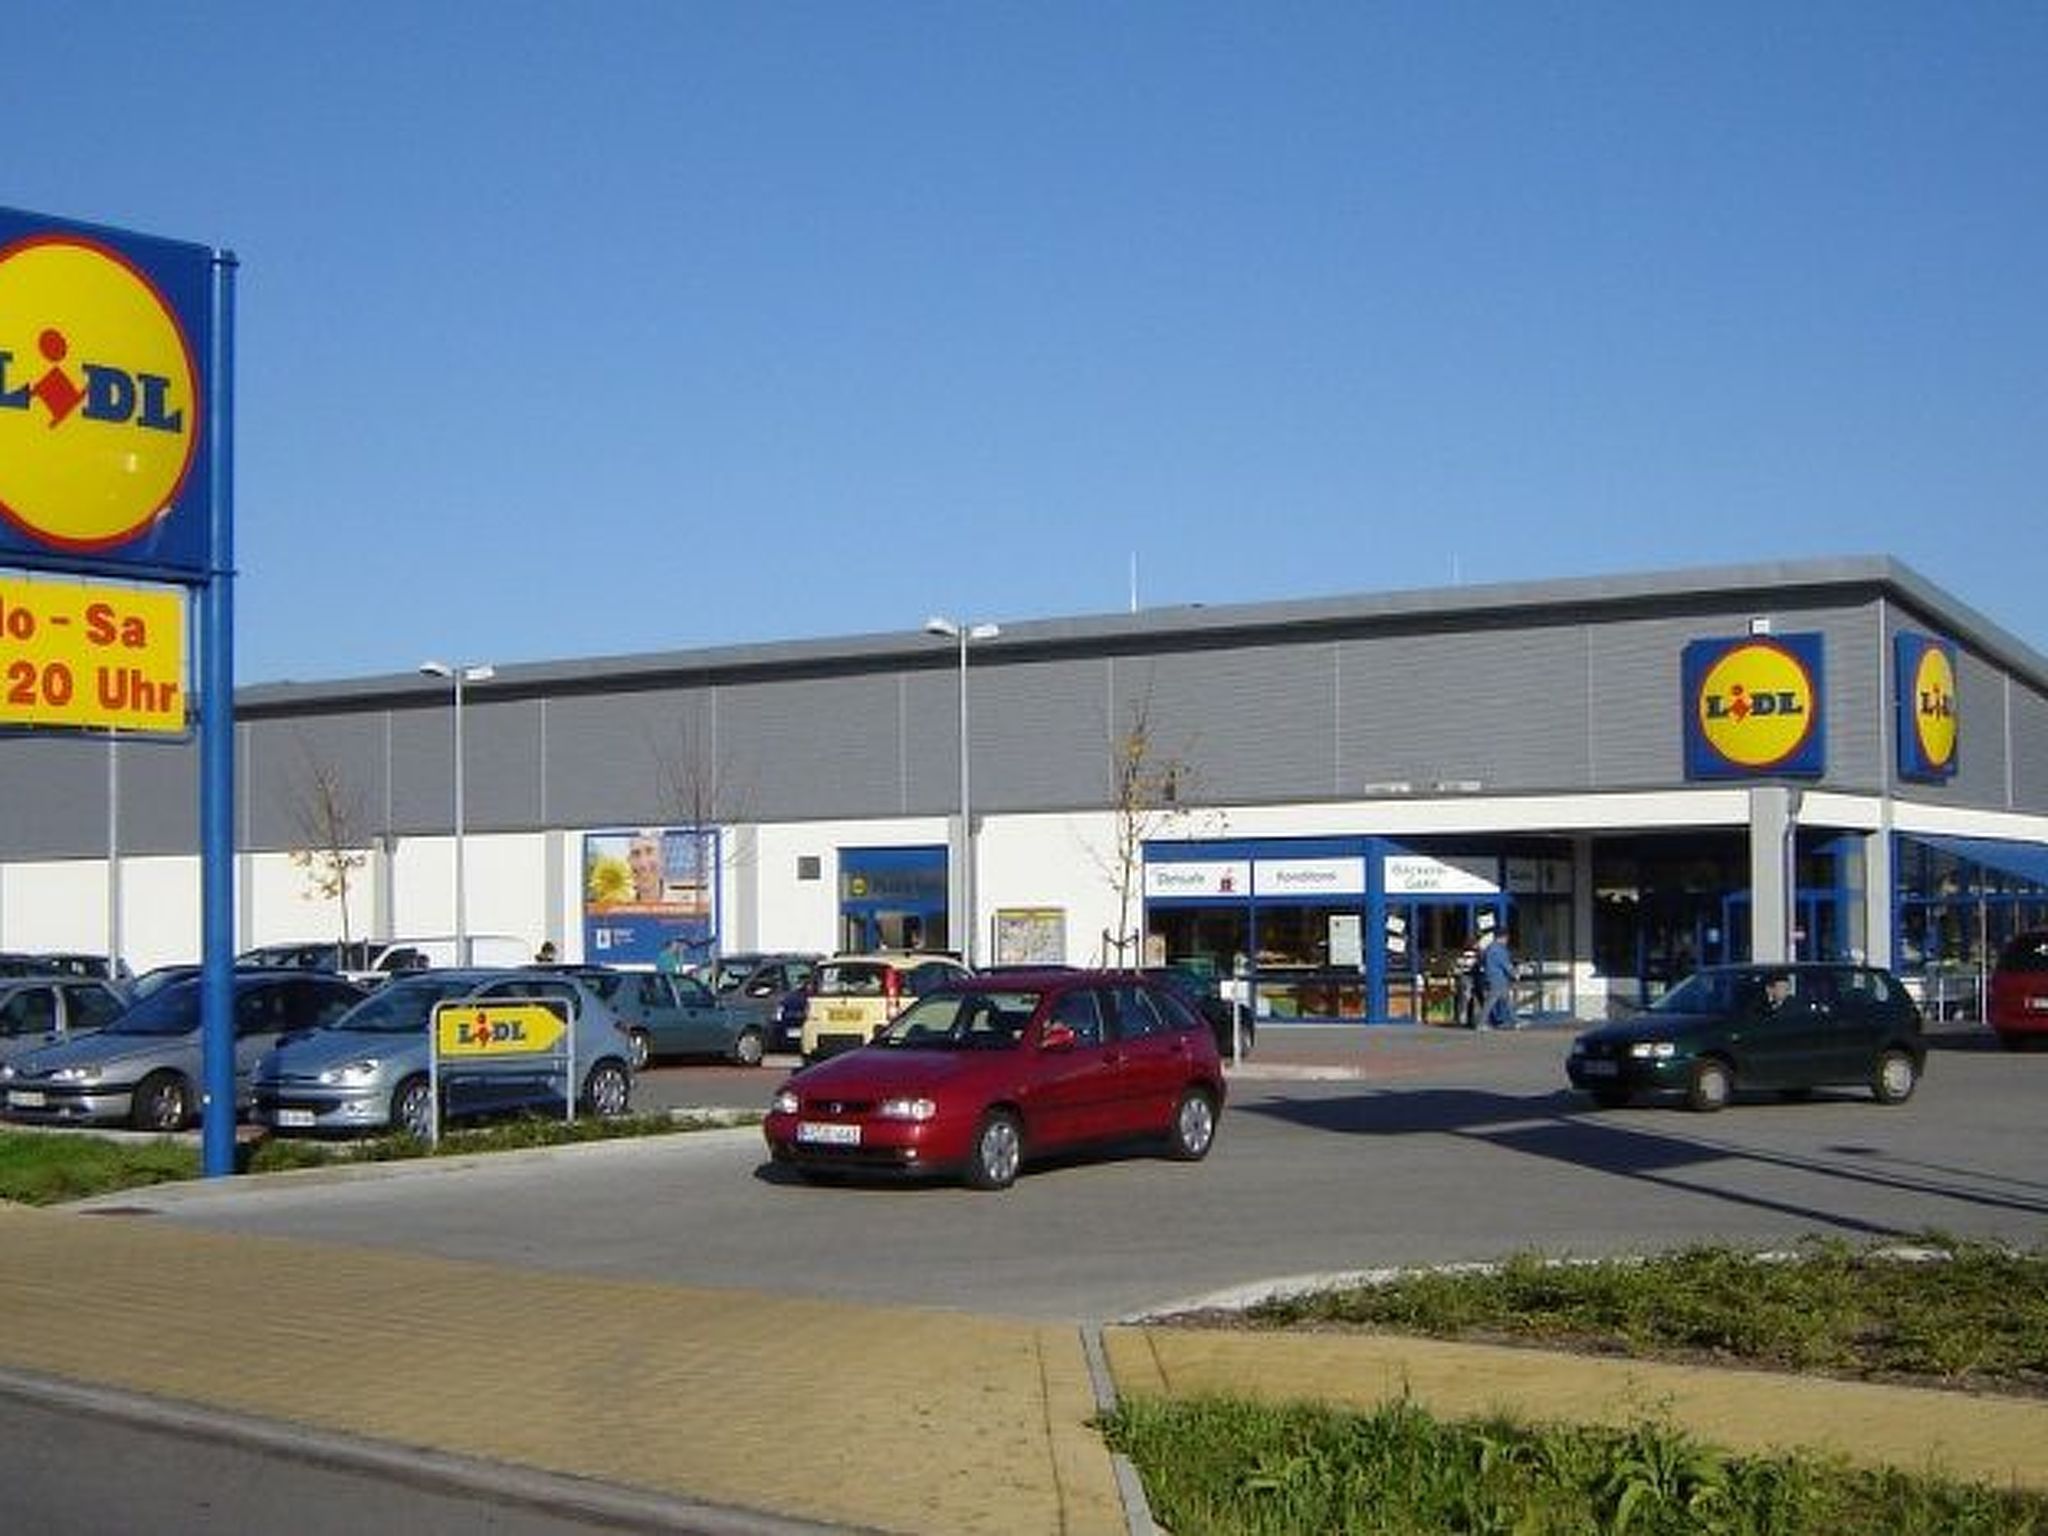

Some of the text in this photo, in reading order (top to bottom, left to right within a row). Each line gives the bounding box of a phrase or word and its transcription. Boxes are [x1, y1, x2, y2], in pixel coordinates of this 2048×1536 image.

[0, 595, 35, 640] o
[86, 603, 147, 648] Sa
[7, 661, 178, 713] 20 Uhr
